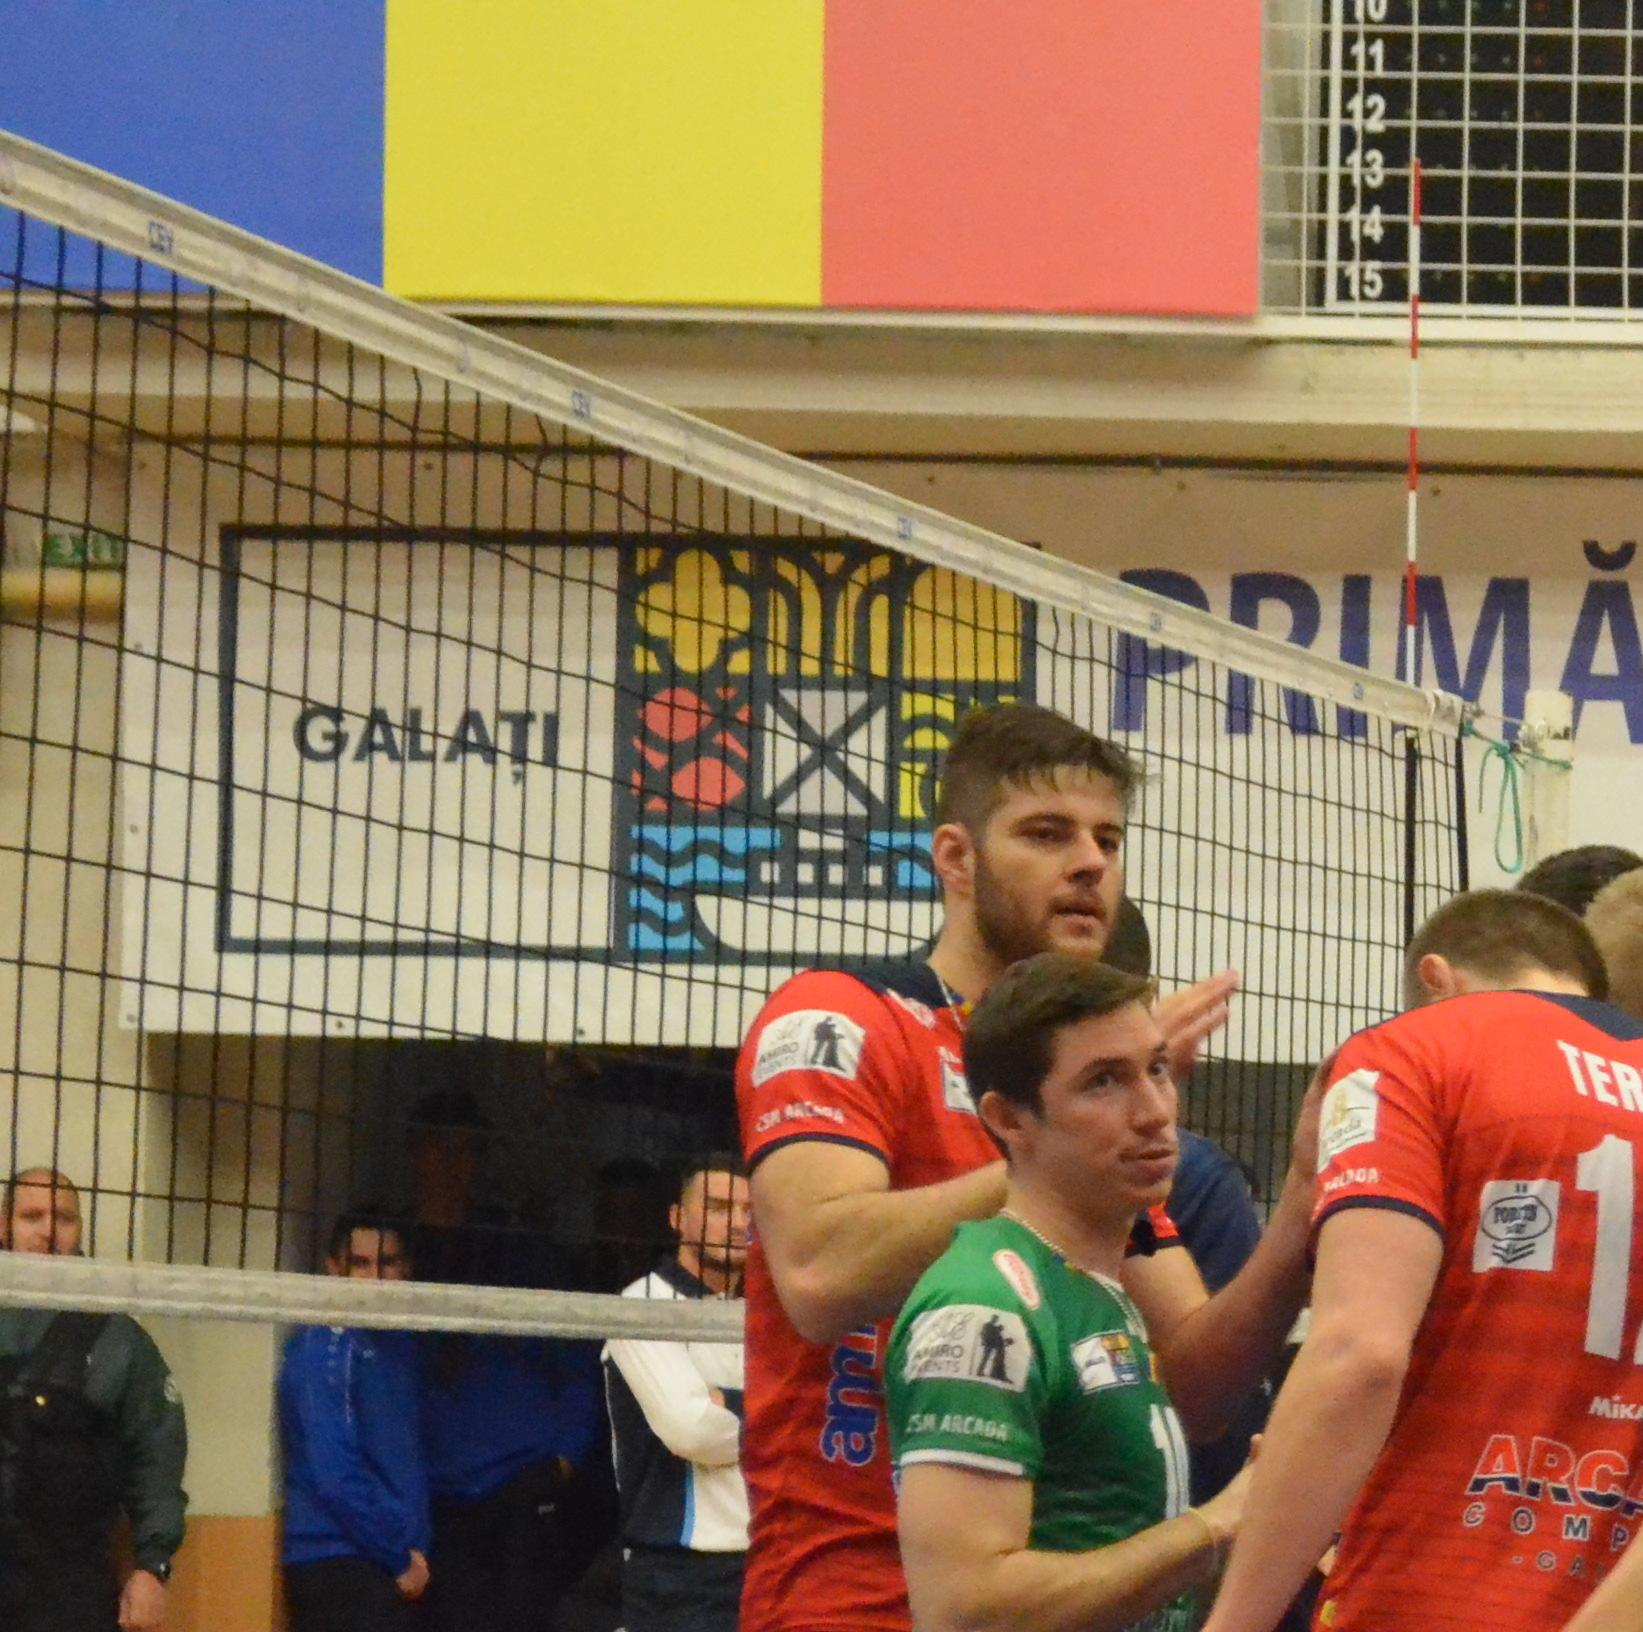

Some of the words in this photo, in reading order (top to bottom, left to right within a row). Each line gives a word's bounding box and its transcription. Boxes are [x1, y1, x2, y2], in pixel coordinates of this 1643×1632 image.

[1350, 38, 1385, 76] 11
[1346, 93, 1387, 133] 12
[1346, 148, 1384, 189] 13
[1346, 203, 1384, 244] 14
[1343, 259, 1383, 300] 15
[292, 705, 561, 786] GALAȚI
[1462, 1501, 1631, 1551] COMP
